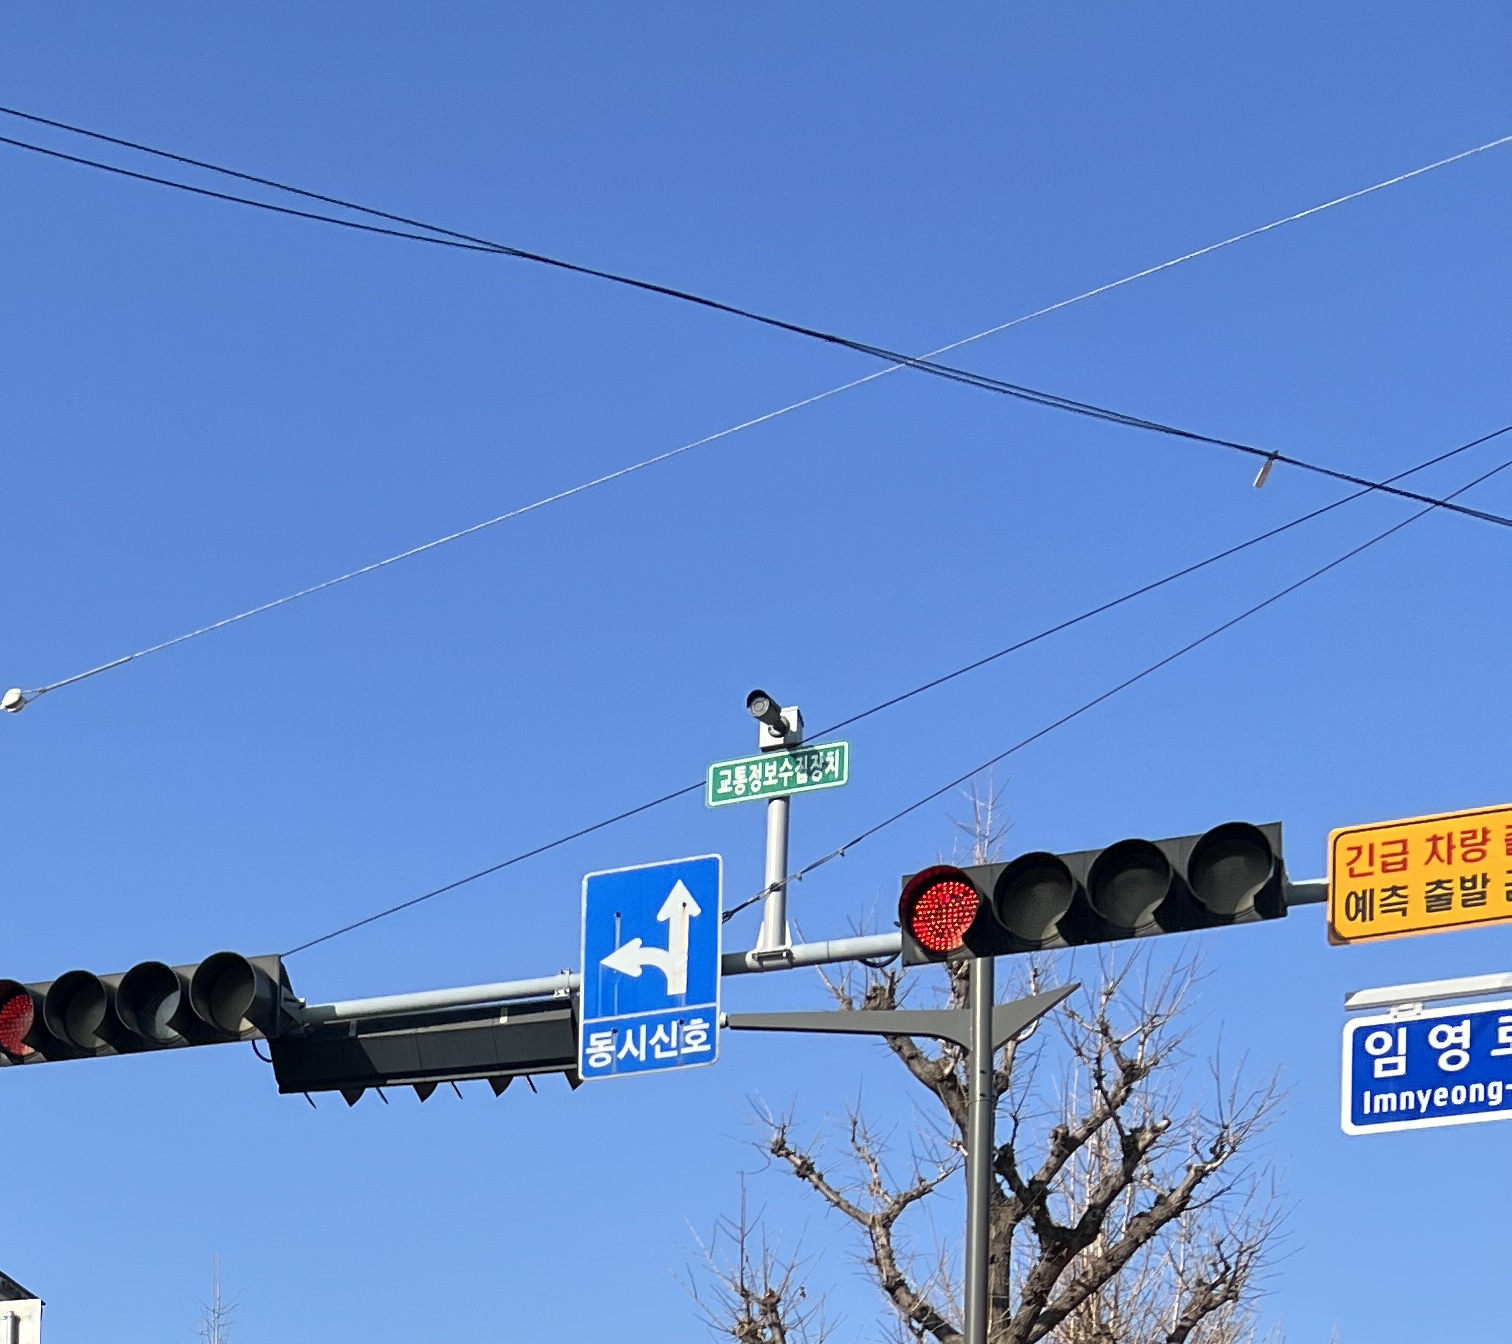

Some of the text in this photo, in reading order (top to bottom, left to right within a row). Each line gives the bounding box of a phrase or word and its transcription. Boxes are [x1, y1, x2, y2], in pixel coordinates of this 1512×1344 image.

[717, 748, 840, 796] 교통정보수집장치
[1346, 838, 1409, 878] 긴급
[1424, 827, 1491, 865] 차량
[1345, 884, 1409, 922] 예측
[1424, 872, 1491, 913] 출발
[585, 1017, 712, 1068] 동시신호
